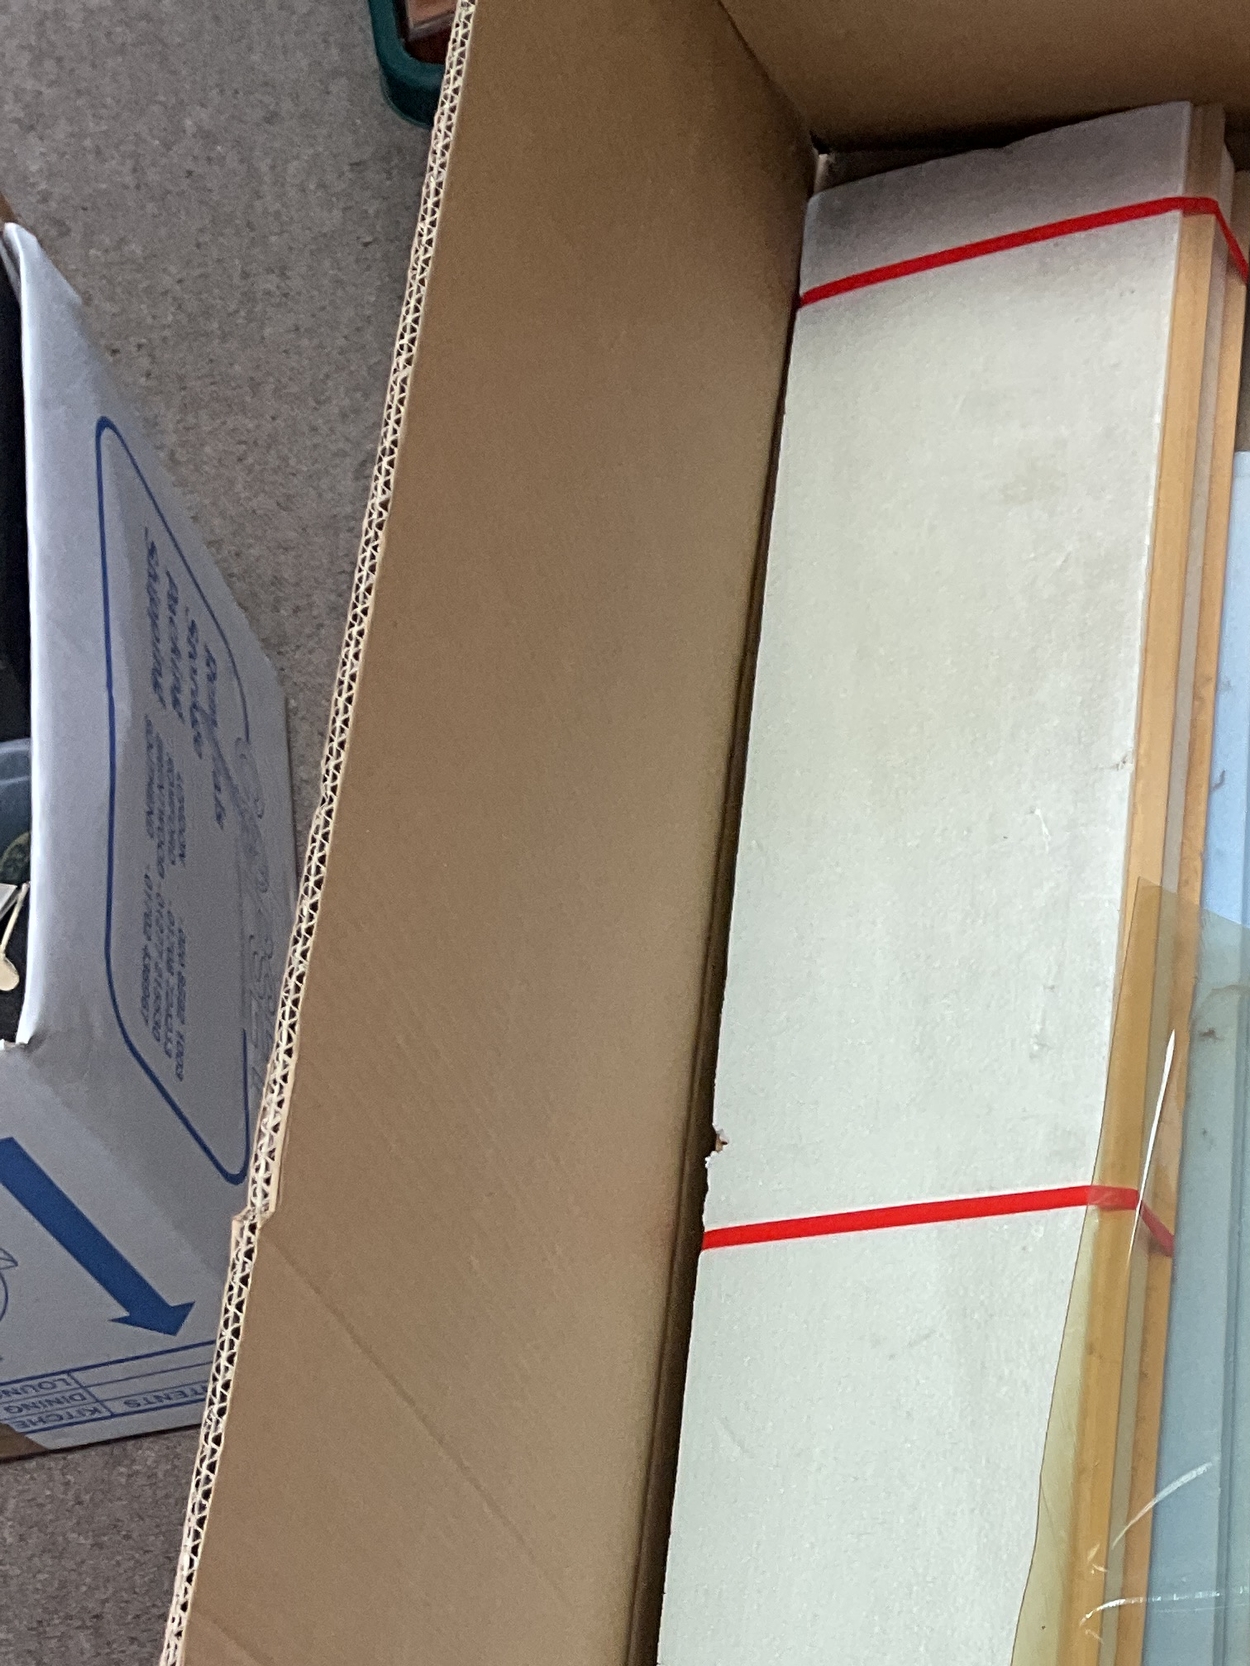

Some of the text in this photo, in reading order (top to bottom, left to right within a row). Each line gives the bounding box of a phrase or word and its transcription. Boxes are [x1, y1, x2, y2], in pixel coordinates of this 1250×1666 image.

[145, 526, 167, 710] Shipping
[166, 570, 186, 725] Packing
[0, 1377, 73, 1398] LOUN
[4, 1392, 88, 1415] DINING
[14, 1405, 101, 1430] KITCHE
